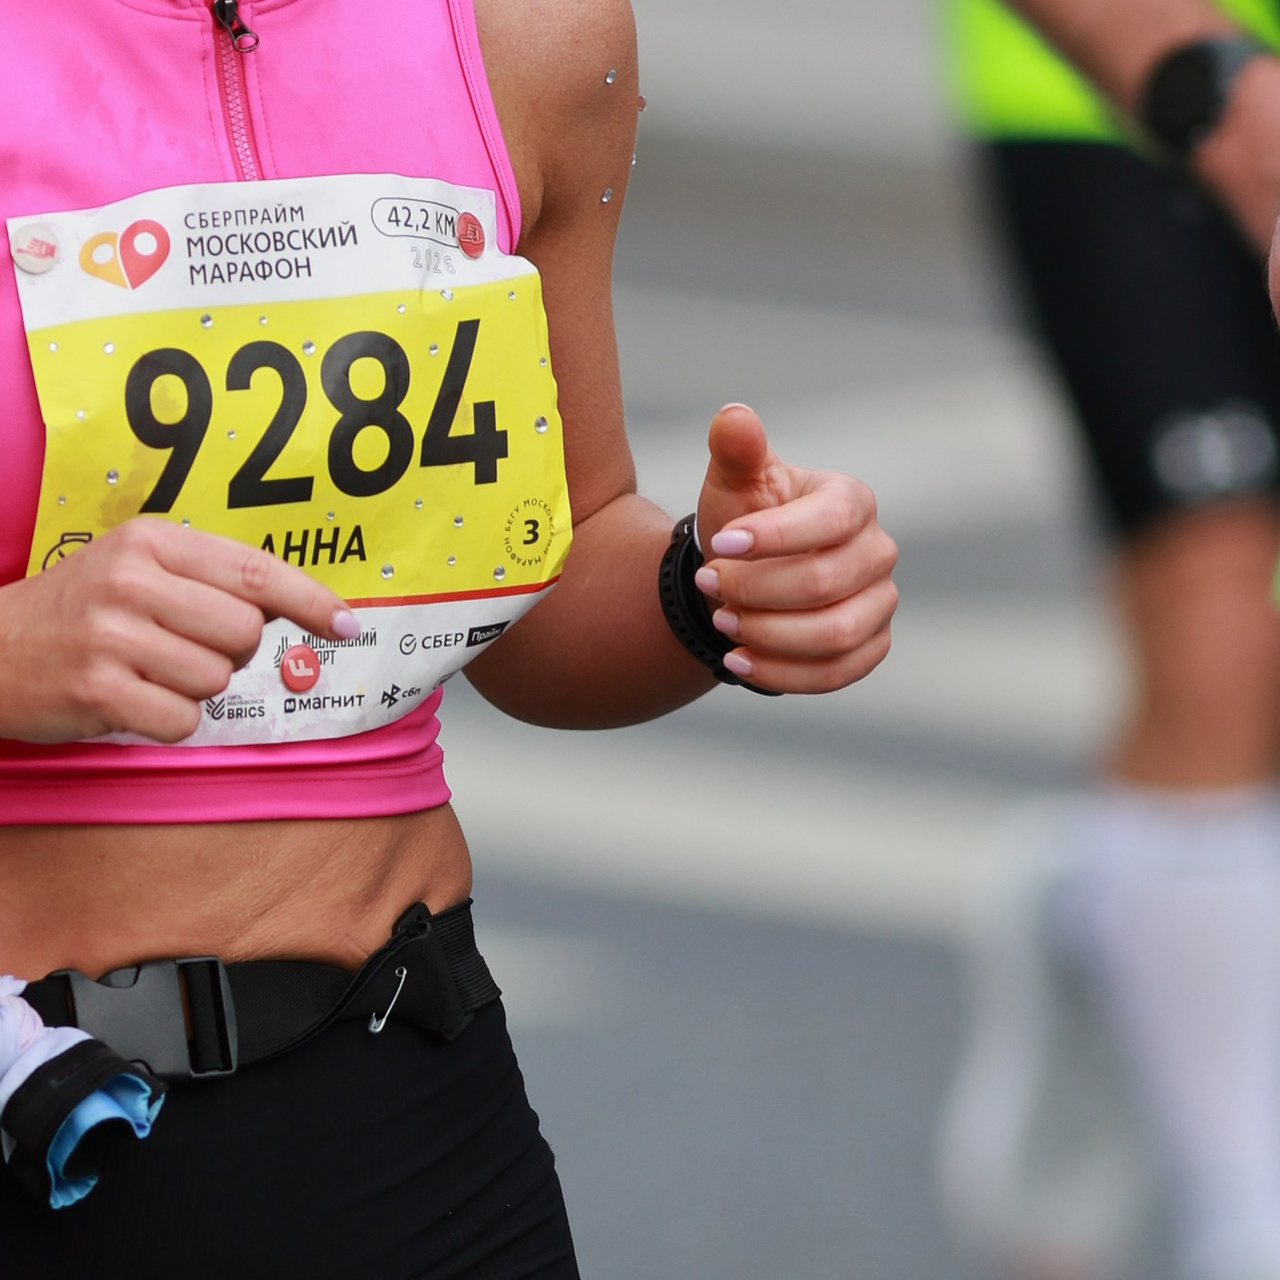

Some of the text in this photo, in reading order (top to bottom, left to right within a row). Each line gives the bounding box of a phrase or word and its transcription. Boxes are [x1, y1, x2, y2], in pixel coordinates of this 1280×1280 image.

[184, 203, 305, 229] СБЕРПРАЙМ
[387, 205, 430, 232] 42,2
[186, 220, 358, 257] МОСКОВСКИЙ
[189, 256, 312, 285] МАРАФОН
[124, 318, 509, 514] 9284
[523, 519, 539, 545] 3
[504, 537, 542, 566] МАРАФОН
[422, 632, 464, 650] СБЕР
[227, 705, 265, 719] BRICS
